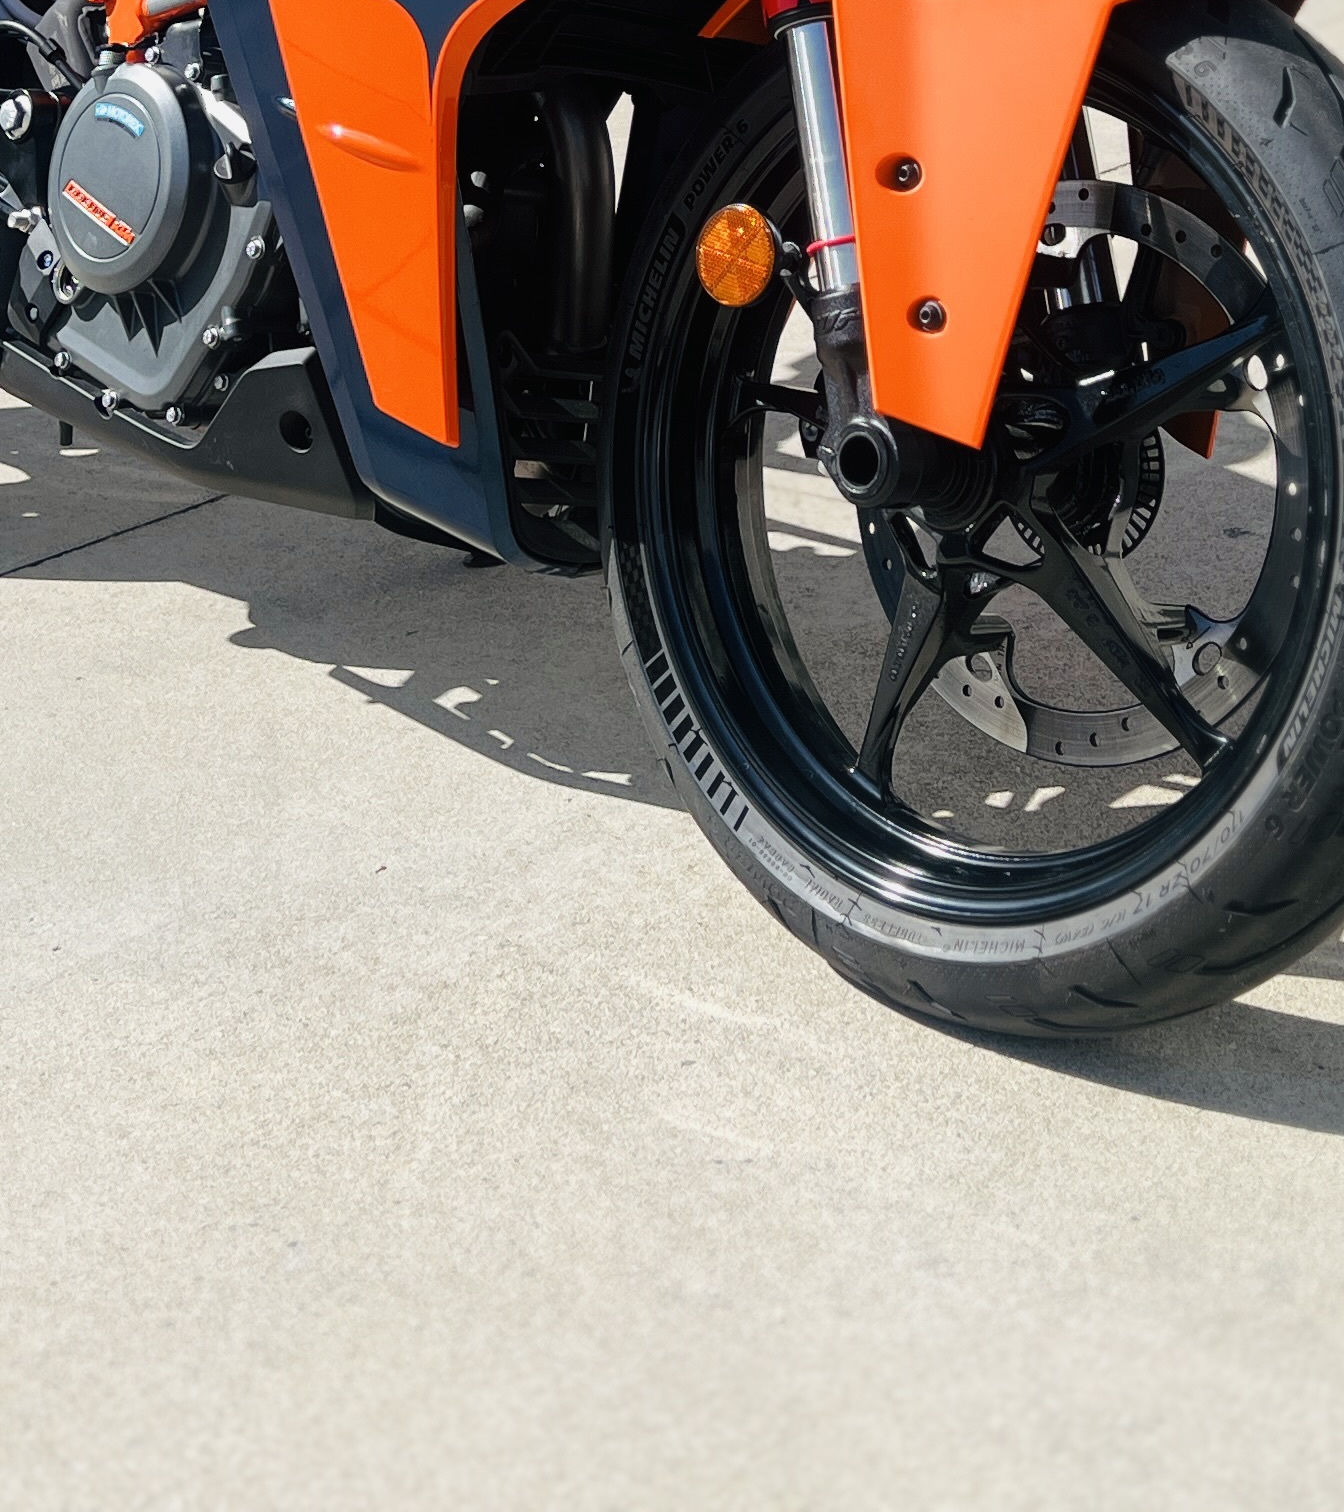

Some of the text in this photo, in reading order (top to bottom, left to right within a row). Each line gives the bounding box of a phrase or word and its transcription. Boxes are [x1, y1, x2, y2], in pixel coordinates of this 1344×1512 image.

[629, 119, 749, 360] MICHELIN POWER 6
[1283, 593, 1343, 759] MICHELIN
[1189, 809, 1245, 874] 110/70
